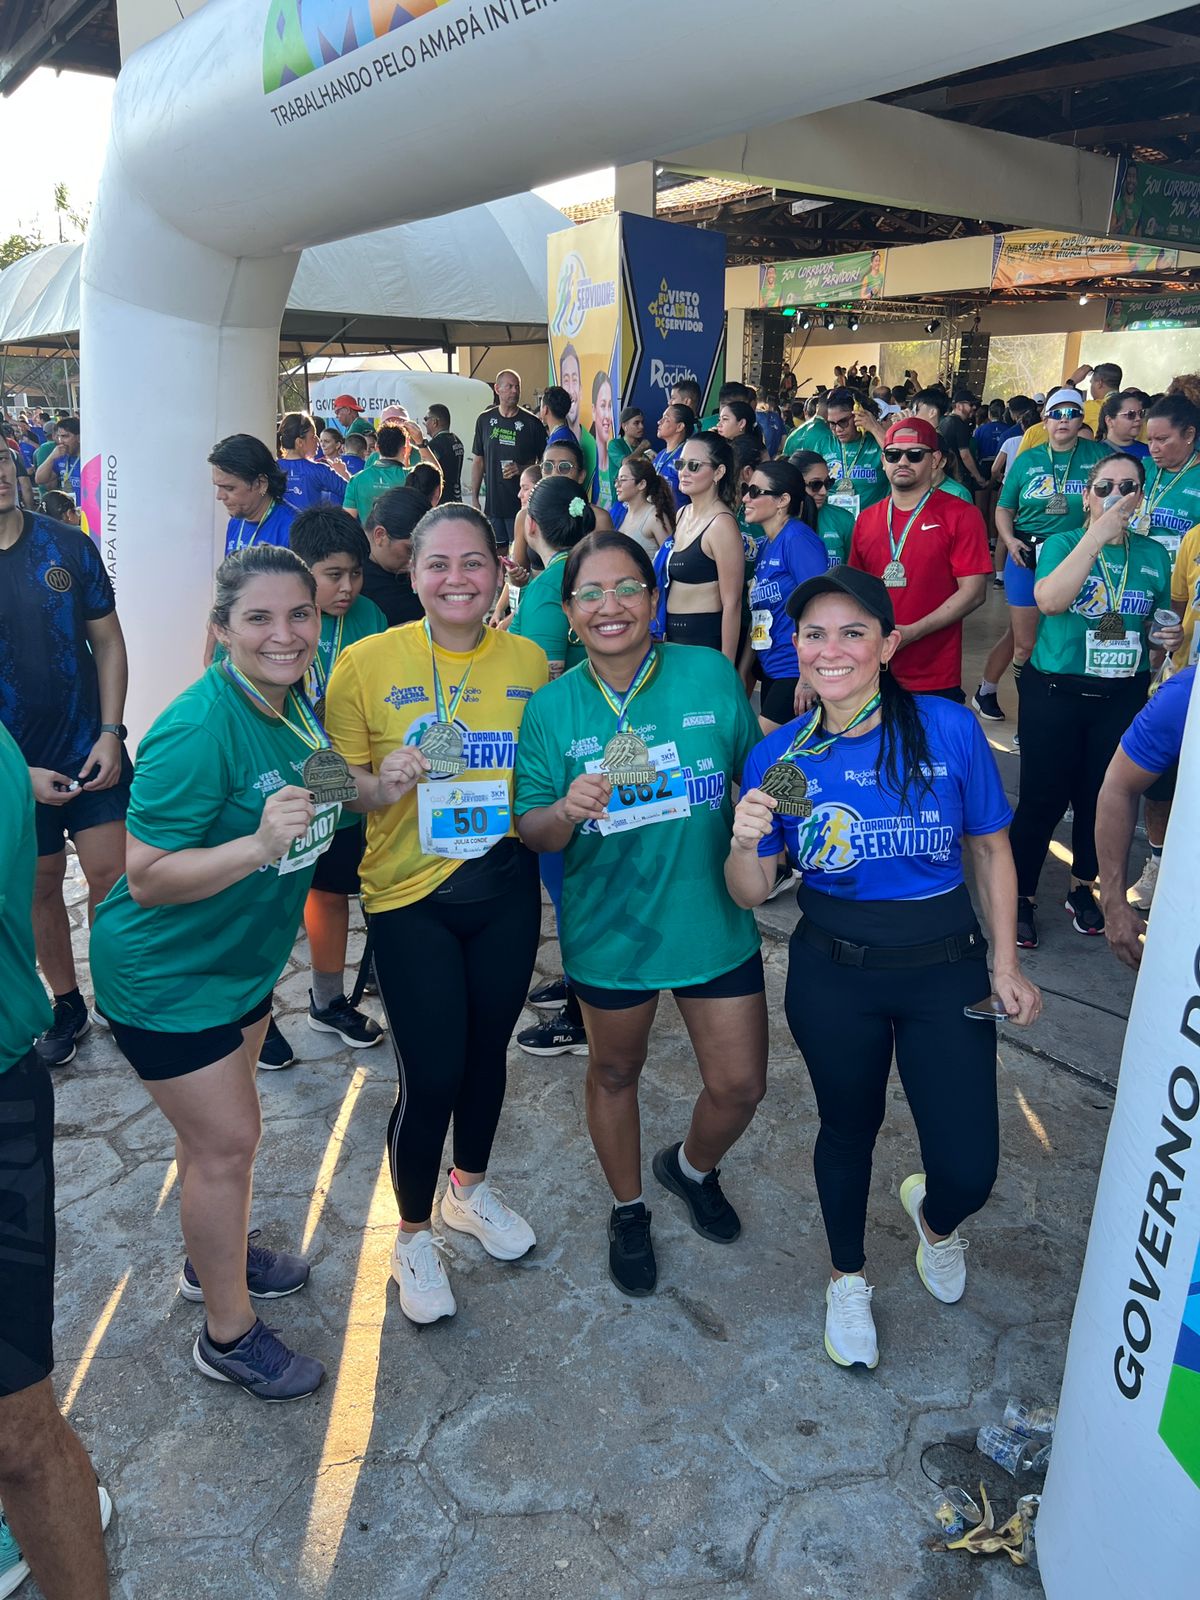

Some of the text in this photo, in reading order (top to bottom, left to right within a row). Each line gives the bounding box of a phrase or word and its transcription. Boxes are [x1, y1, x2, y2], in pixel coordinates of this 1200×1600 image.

[270, 66, 373, 127] TRABALHANDO
[372, 45, 417, 82] PELO
[418, 6, 485, 63] AMAPÁ
[1143, 175, 1162, 197] SOU
[780, 262, 834, 283] SOU CORREDOR
[804, 277, 819, 291] SOU
[577, 281, 611, 311] SERVIDOR
[668, 290, 700, 306] VISTO
[663, 304, 700, 319] CAMISA
[665, 319, 703, 332] SERVIDOR
[107, 454, 118, 532] INTEIRO
[1150, 513, 1193, 532] ERVIDOR
[1093, 651, 1133, 665] 52201
[468, 732, 500, 742] CORRIDA
[502, 732, 513, 742] DO
[632, 723, 657, 735] odolfo
[463, 744, 518, 769] SERVI
[660, 753, 676, 763] 3KM
[696, 757, 714, 772] 5KM
[603, 771, 649, 785] ERVIDOR
[454, 806, 488, 835] 50
[859, 819, 899, 832] CORRIDA
[899, 817, 914, 829] DO
[919, 810, 940, 824] 7KM
[294, 812, 335, 853] 50107
[851, 828, 952, 860] SERVIDOR
[553, 1034, 573, 1044] FILA
[1113, 942, 1200, 1400] GOVERNO D
